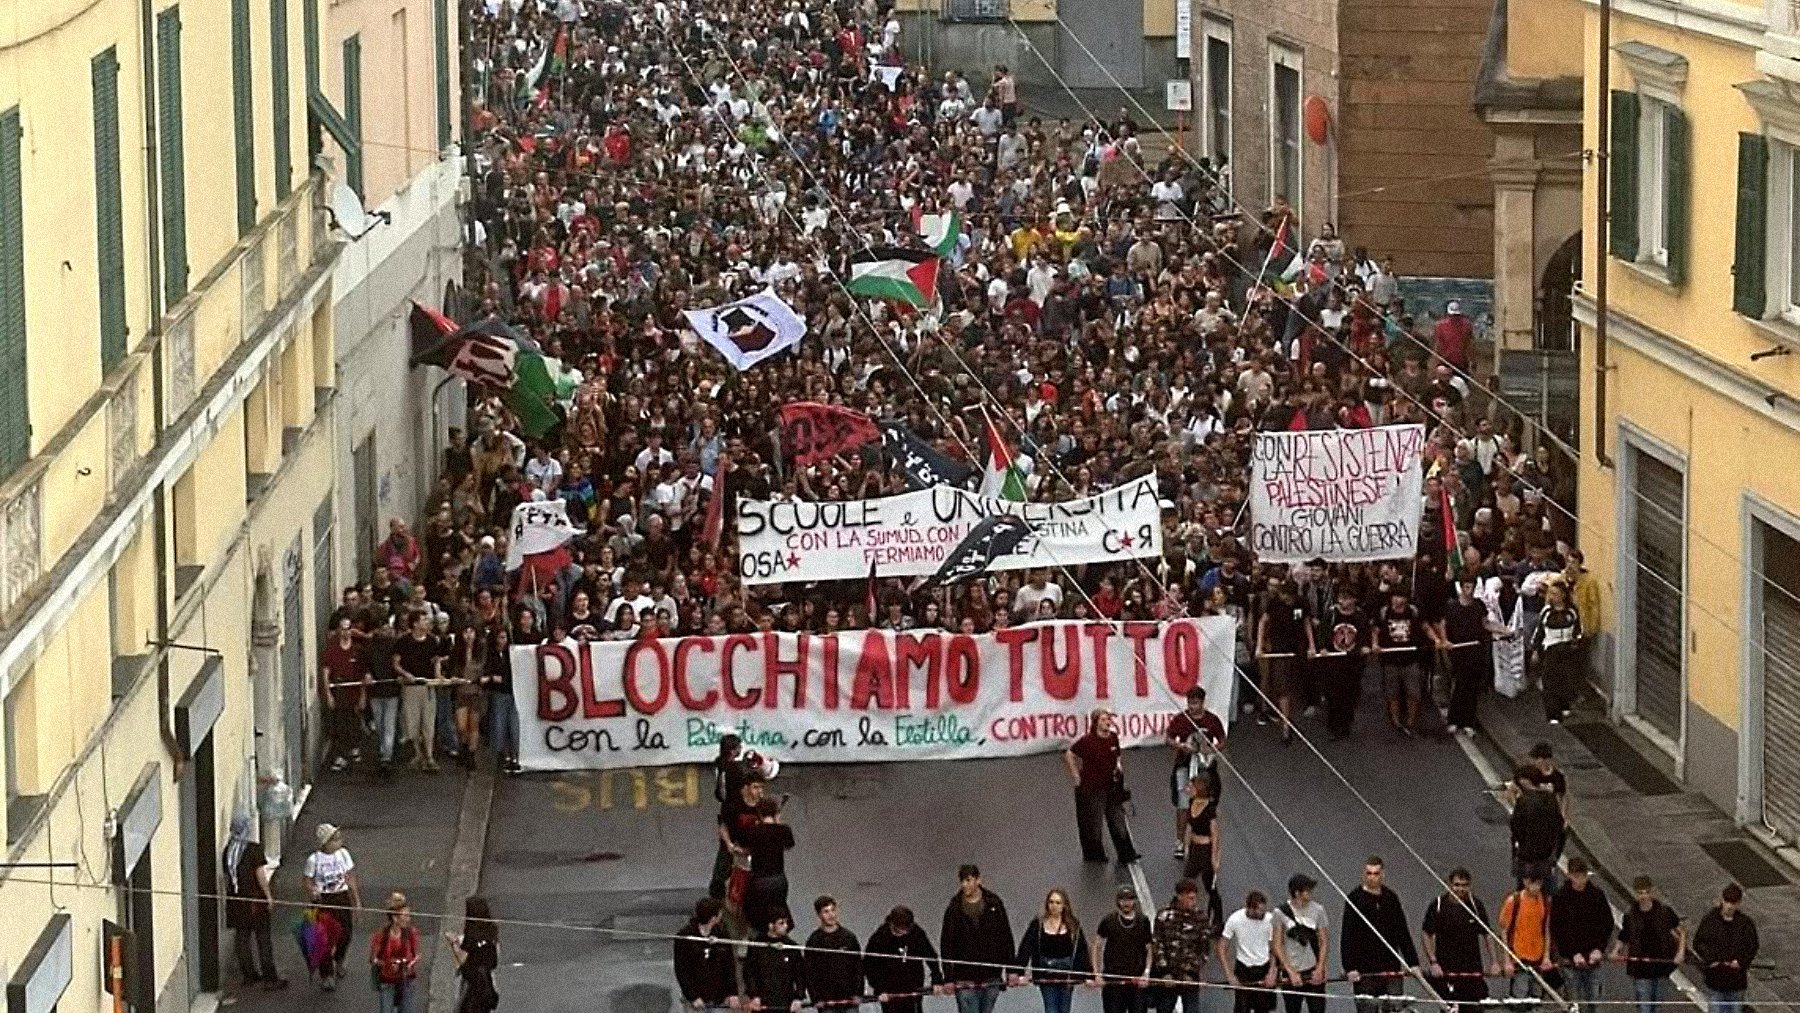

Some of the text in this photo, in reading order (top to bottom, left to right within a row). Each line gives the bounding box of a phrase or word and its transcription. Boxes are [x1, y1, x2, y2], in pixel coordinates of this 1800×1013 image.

[1254, 434, 1290, 461] CON
[1266, 475, 1388, 509] PALESTINESE
[738, 499, 883, 537] SCUOLE
[900, 511, 918, 527] e
[1291, 504, 1364, 528] GIOVANI
[786, 530, 828, 550] CON
[837, 530, 862, 549] LA
[927, 525, 960, 543] CON
[1321, 525, 1344, 553] LA
[1347, 519, 1412, 552] GUERRA
[740, 550, 787, 578] OSA
[863, 545, 945, 565] FERMIAMO
[536, 621, 1201, 722] BLOCCHIAMO TUTTO
[634, 719, 670, 750] la
[803, 726, 847, 747] con
[857, 718, 887, 746] la
[991, 714, 1078, 741] CONTRO
